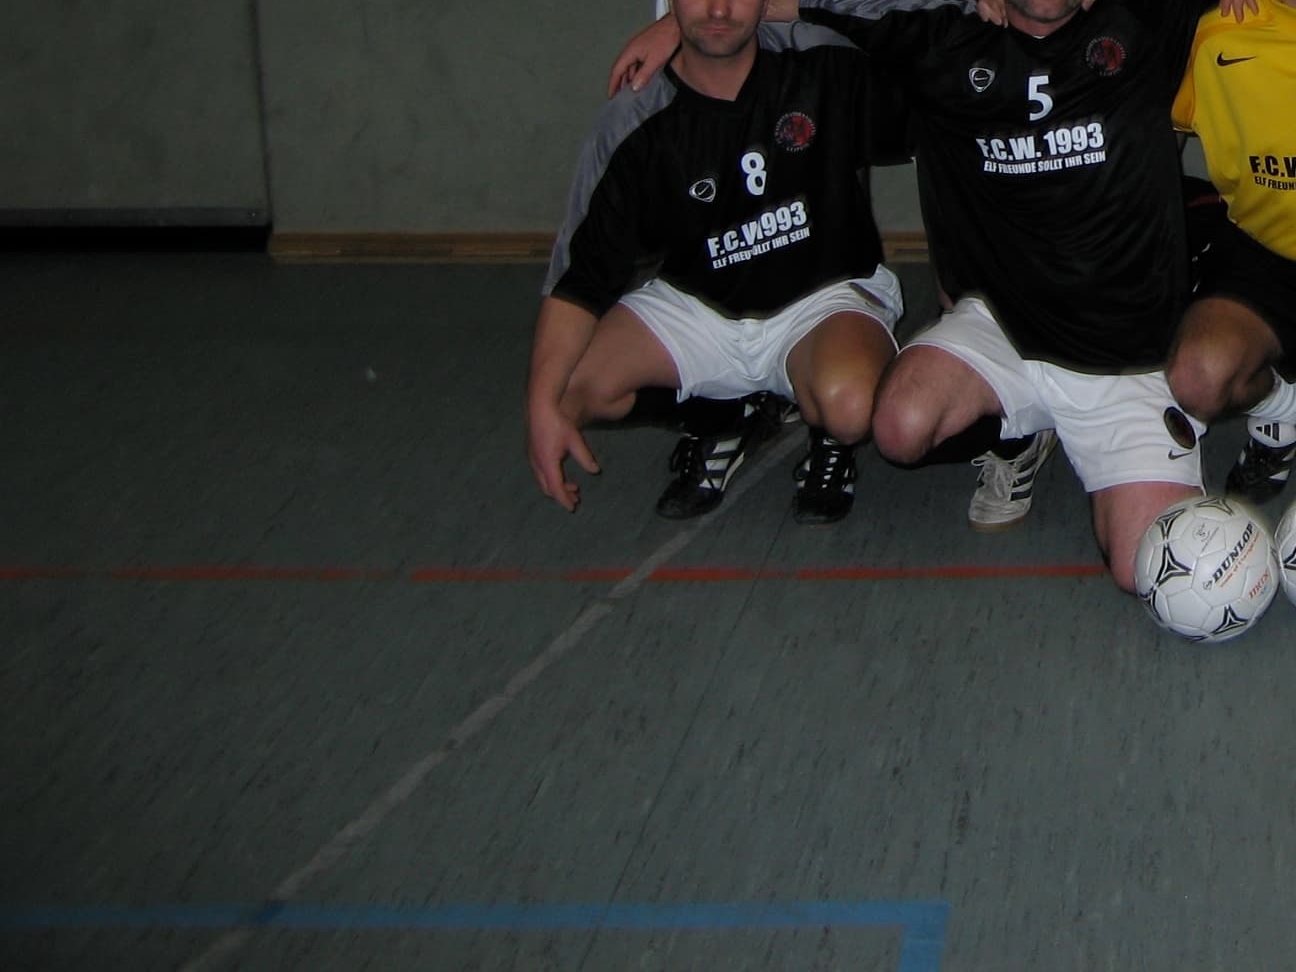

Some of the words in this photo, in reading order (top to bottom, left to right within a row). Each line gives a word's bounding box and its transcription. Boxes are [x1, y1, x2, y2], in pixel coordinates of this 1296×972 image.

[1028, 75, 1054, 121] 5
[1043, 122, 1104, 155] 1993
[741, 152, 767, 195] 8
[984, 160, 997, 172] ELF
[998, 162, 1036, 174] FREUNDE
[1037, 158, 1063, 172] SOLLT
[1064, 155, 1083, 168] IHR
[1083, 150, 1106, 165] SEIN
[712, 257, 728, 269] ELF
[772, 235, 789, 249] IHR
[789, 227, 810, 243] SEIN
[1213, 523, 1253, 583] DUNLOP
